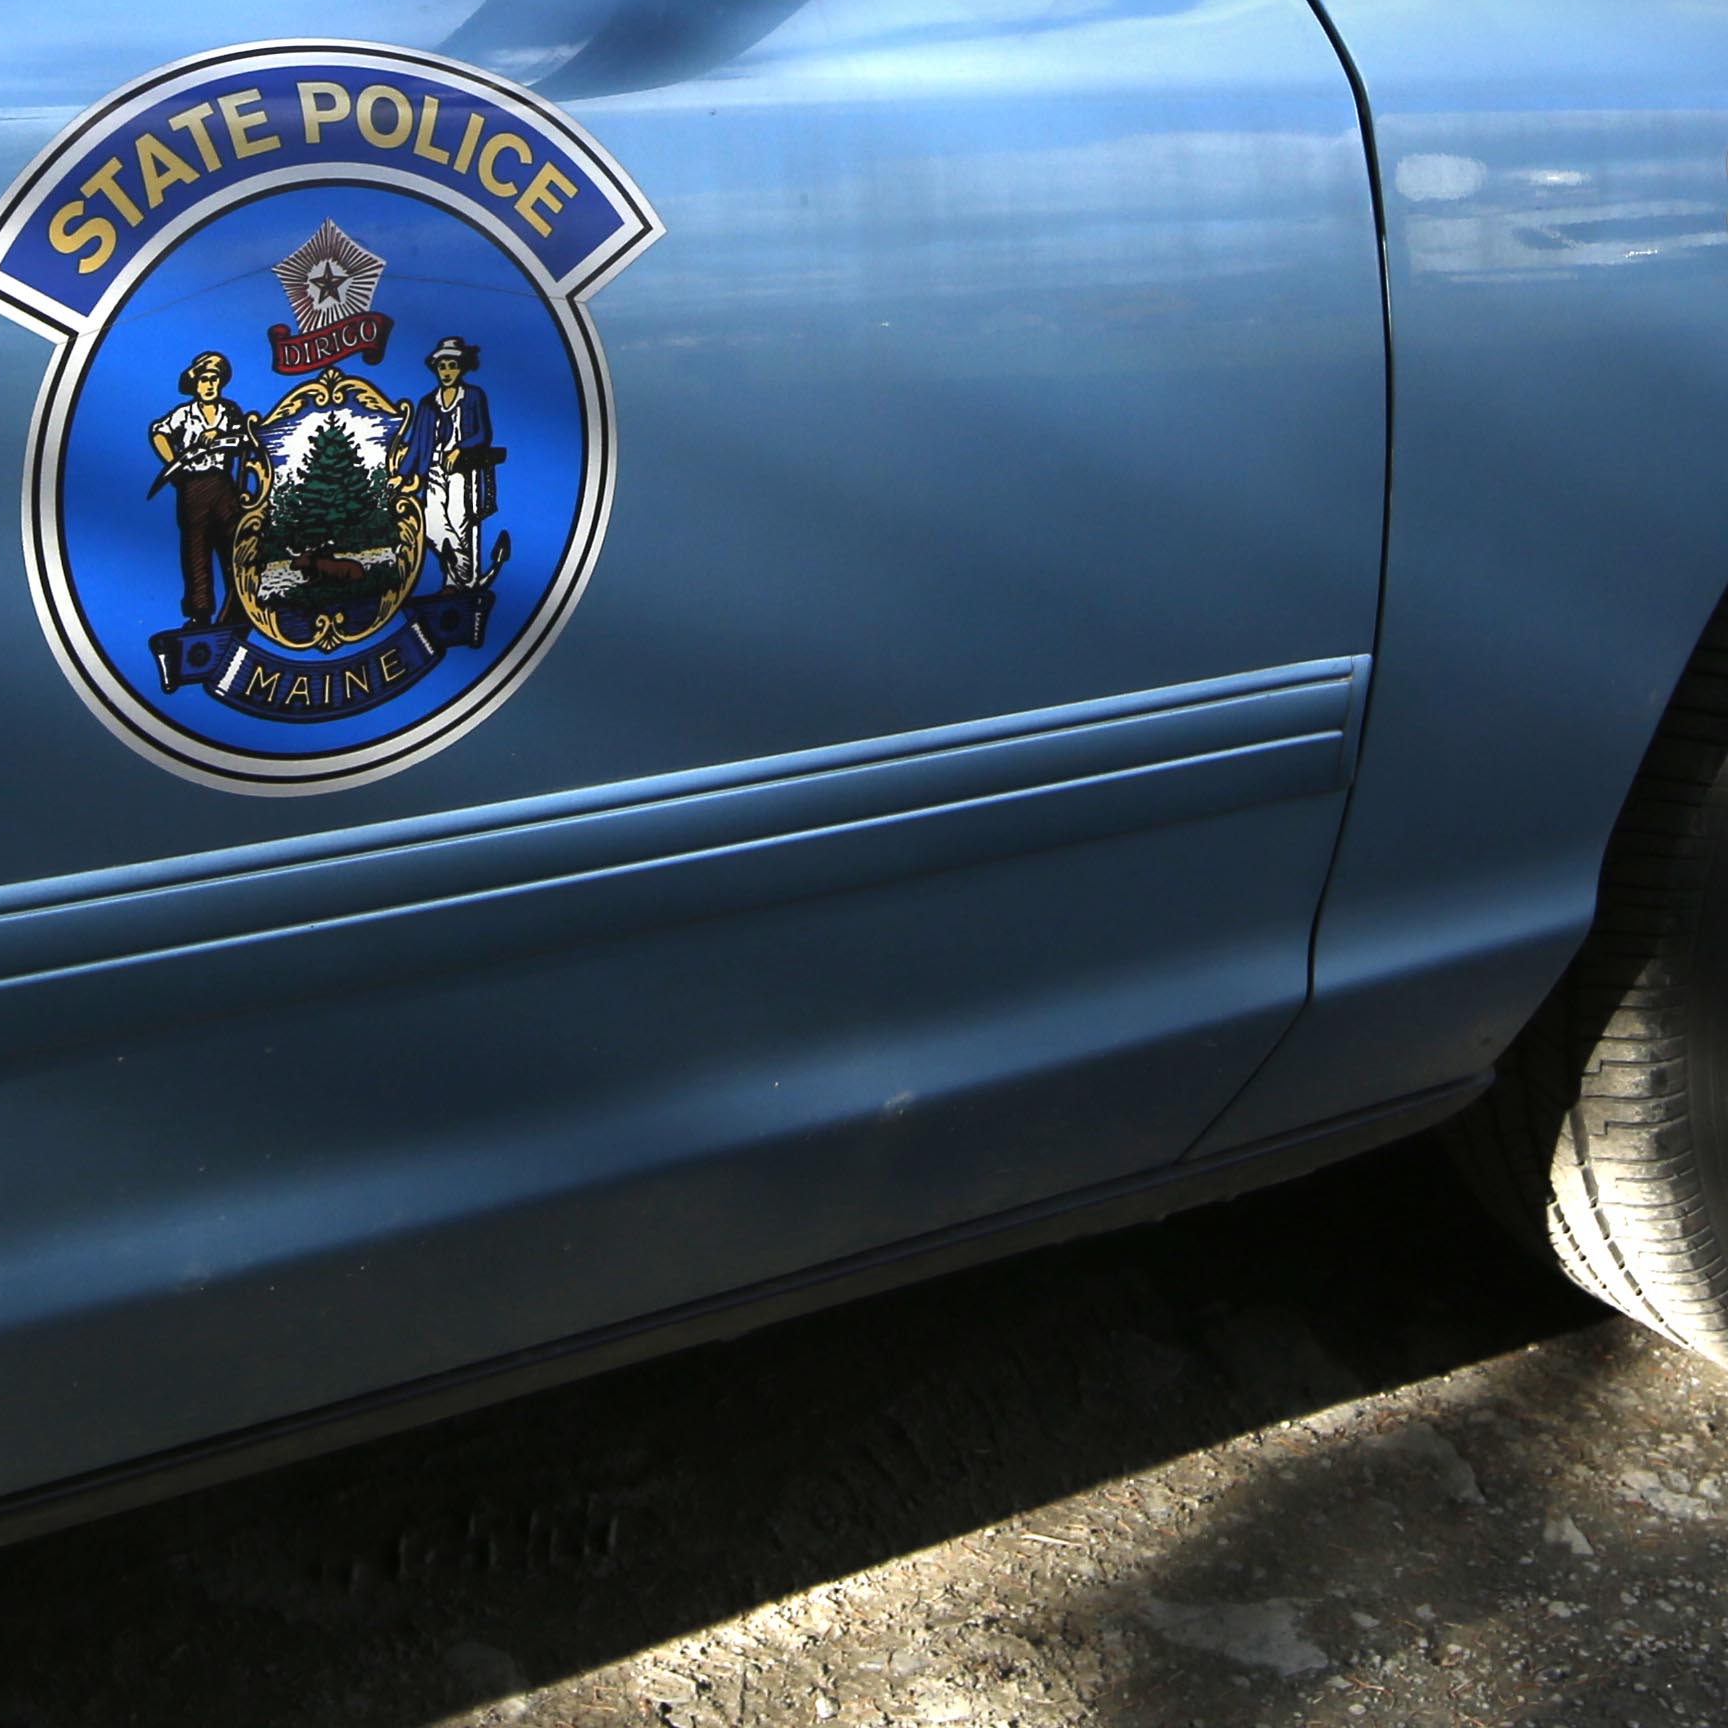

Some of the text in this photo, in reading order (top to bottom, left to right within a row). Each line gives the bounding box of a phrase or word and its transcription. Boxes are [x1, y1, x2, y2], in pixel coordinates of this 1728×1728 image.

[48, 80, 580, 275] STATE POLICE
[244, 647, 407, 707] MAINE
